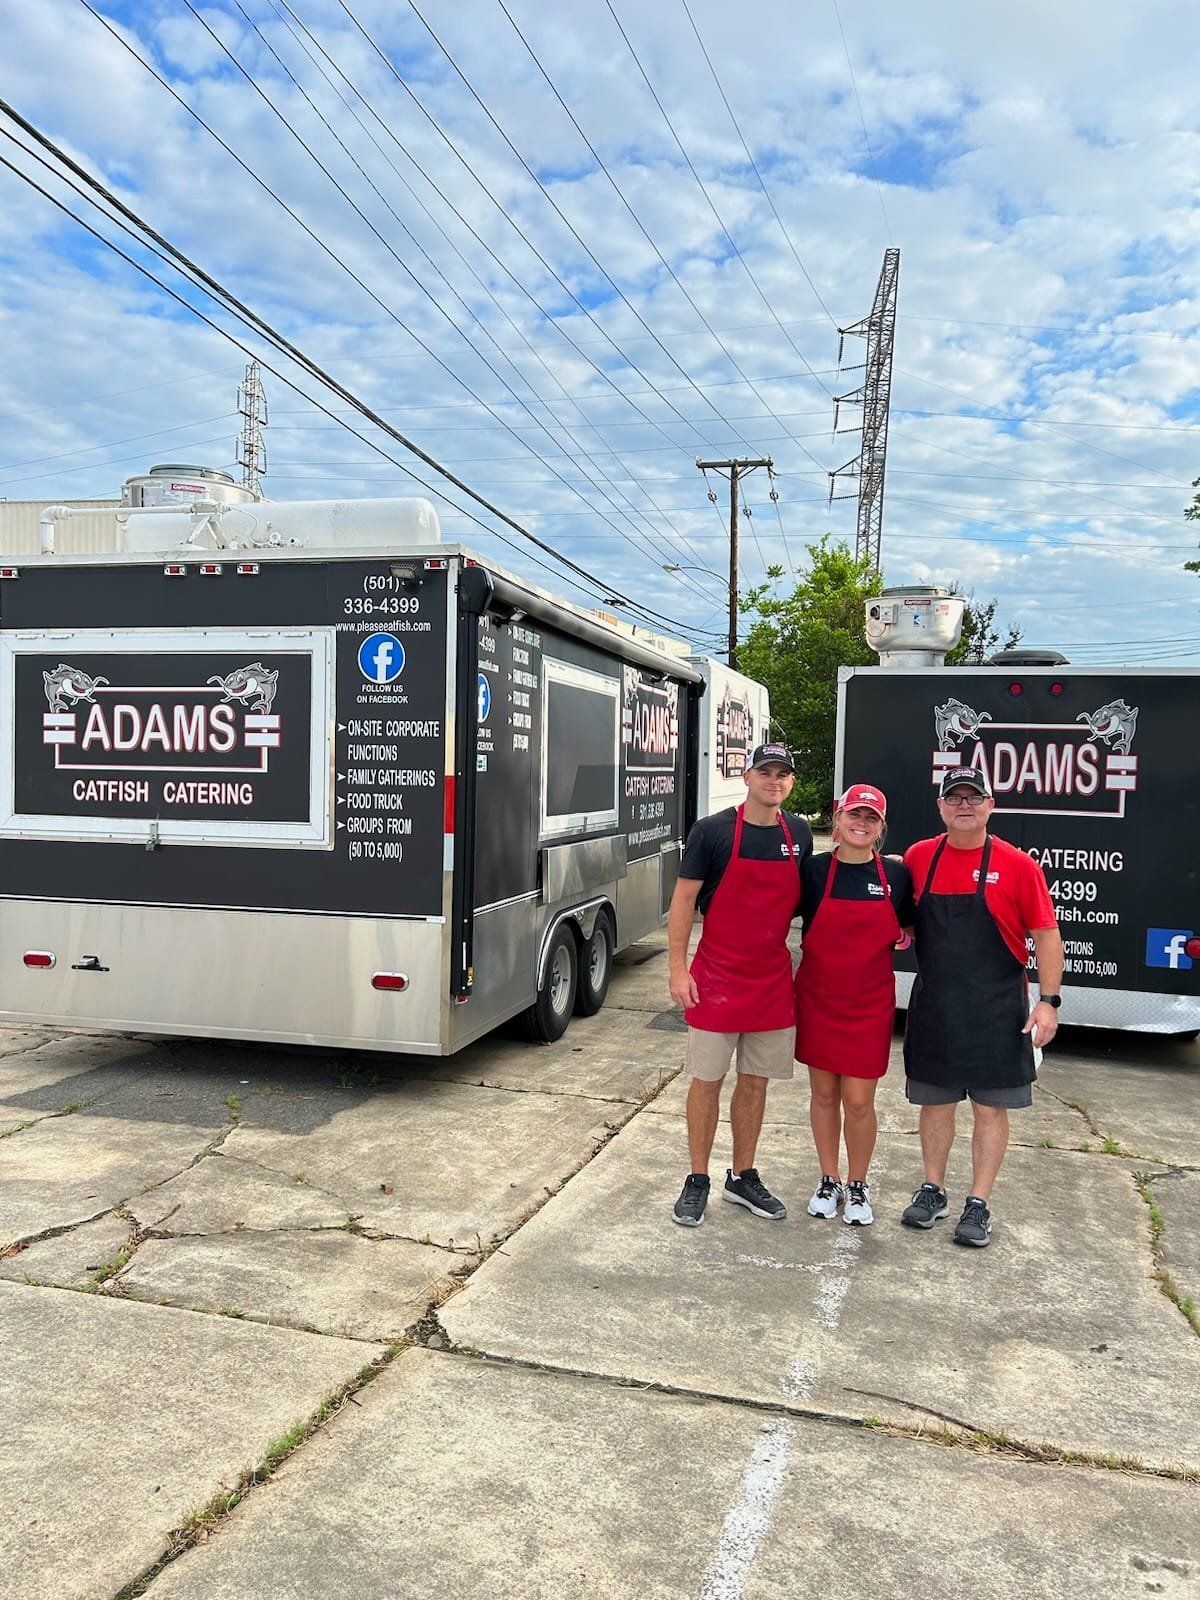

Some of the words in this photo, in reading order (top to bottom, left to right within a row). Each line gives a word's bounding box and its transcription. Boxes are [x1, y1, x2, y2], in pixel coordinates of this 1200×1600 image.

[363, 575, 400, 593] (501)
[343, 597, 420, 615] 336-4399
[335, 619, 431, 633] www.pleaseeatfish.com
[361, 684, 391, 693] FOLLOW
[392, 684, 404, 693] US
[356, 695, 368, 704] ON
[368, 695, 409, 704] FACEBOOK
[80, 703, 237, 753] ADAMS
[347, 719, 383, 737] ON-SITE
[386, 720, 440, 738] CORPORATE
[632, 700, 670, 755] ADAMS
[347, 744, 398, 761] FUNCTIONS
[969, 740, 1101, 796] ADAMS
[347, 768, 377, 786] FAMILY
[378, 769, 436, 788] GATHERINGS
[625, 776, 650, 797] CATFISH
[651, 775, 675, 795] CATERING
[72, 779, 149, 803] CATFISH
[163, 782, 254, 806] CATERING
[347, 792, 372, 809] FOOD
[373, 793, 403, 811] TRUCK
[347, 816, 384, 834] GROUPS
[386, 817, 412, 835] FROM
[348, 841, 362, 861] (50
[363, 841, 376, 859] TO
[376, 841, 403, 862] 5,000)
[1027, 847, 1124, 872] CATERING
[1049, 879, 1098, 902] 4399
[1073, 959, 1084, 973] 50
[1084, 960, 1096, 974] TO
[1096, 961, 1118, 977] 5,000
